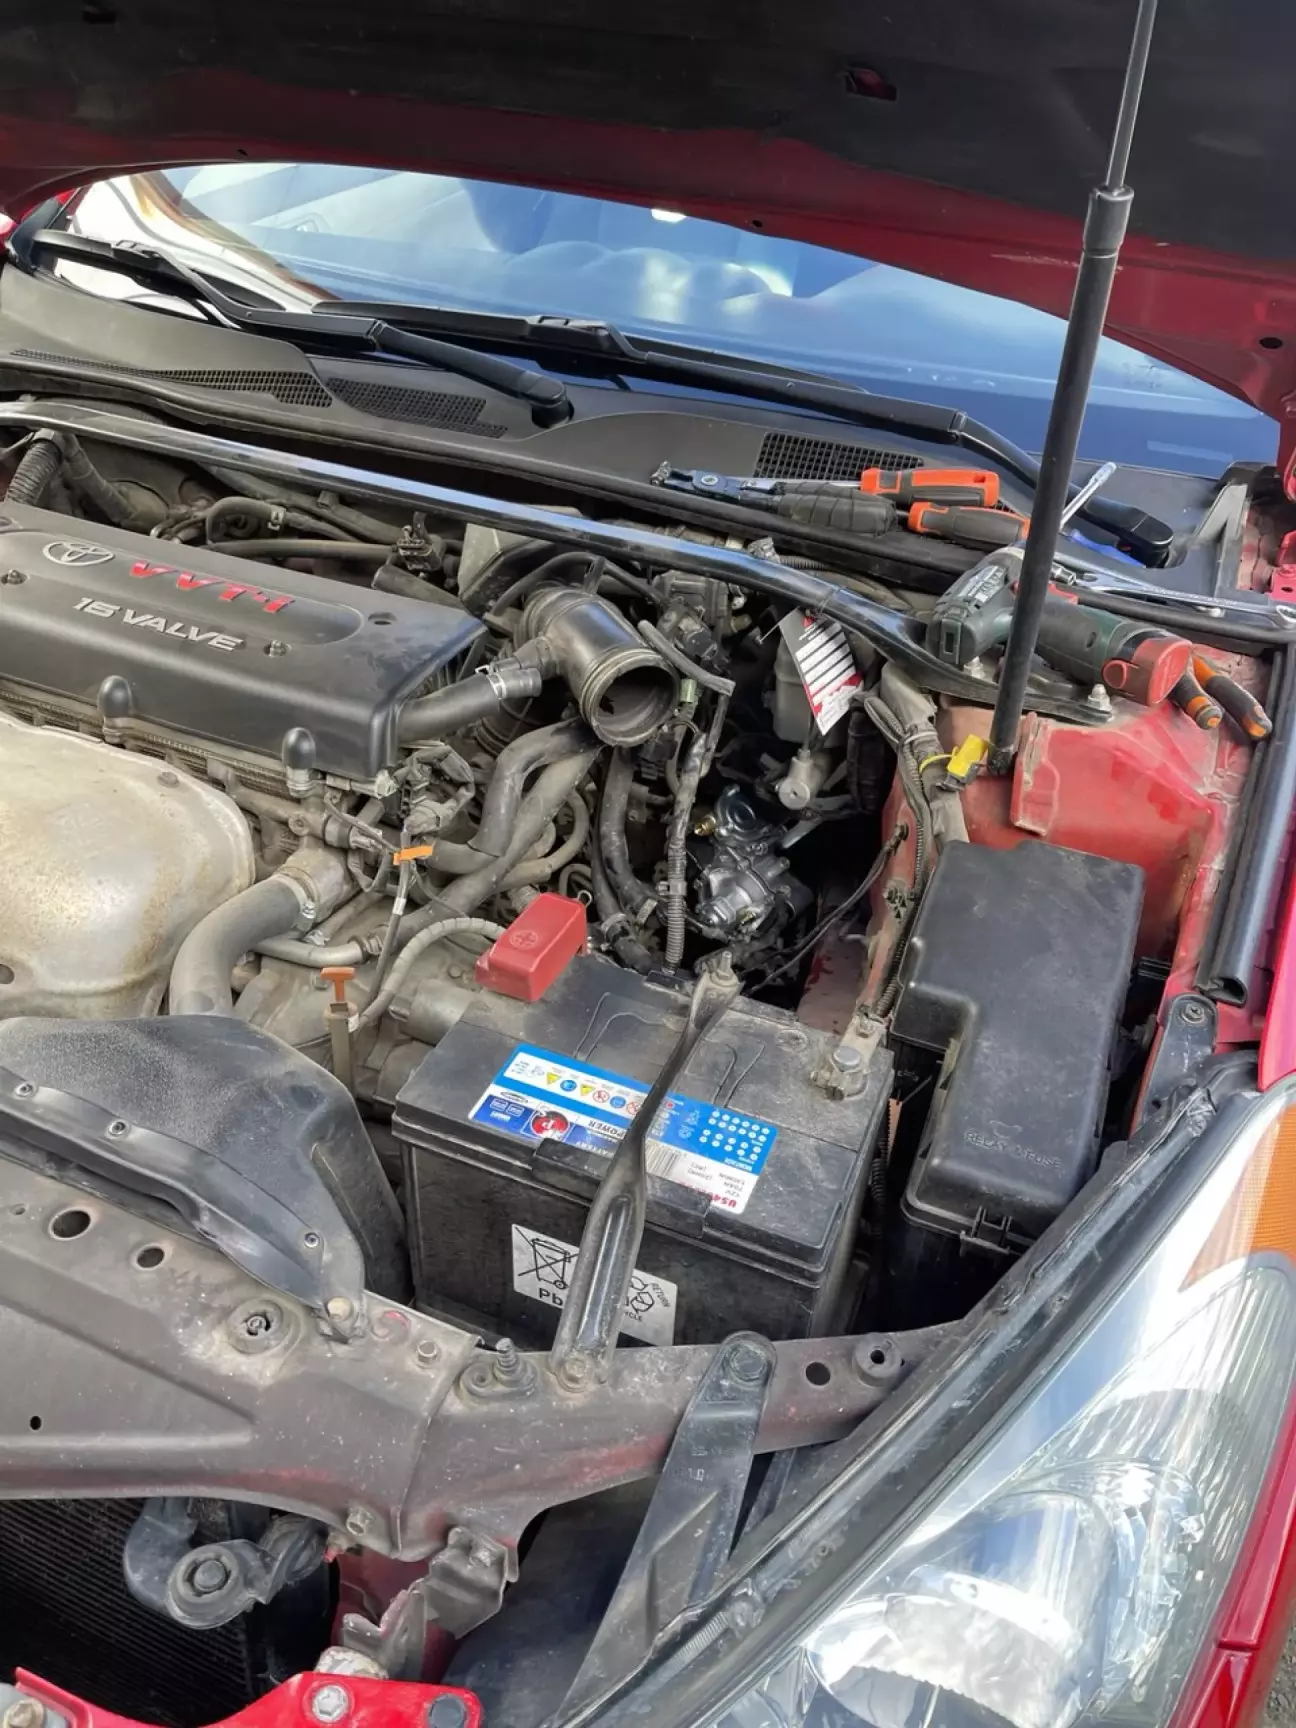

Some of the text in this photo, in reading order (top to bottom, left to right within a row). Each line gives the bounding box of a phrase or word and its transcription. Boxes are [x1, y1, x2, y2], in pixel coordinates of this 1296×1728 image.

[73, 597, 245, 652] 16 VALVE
[588, 1119, 626, 1139] POWER
[964, 1128, 1008, 1153] RELAY
[1023, 1148, 1063, 1169] FUSE
[539, 1287, 564, 1306] Pb
